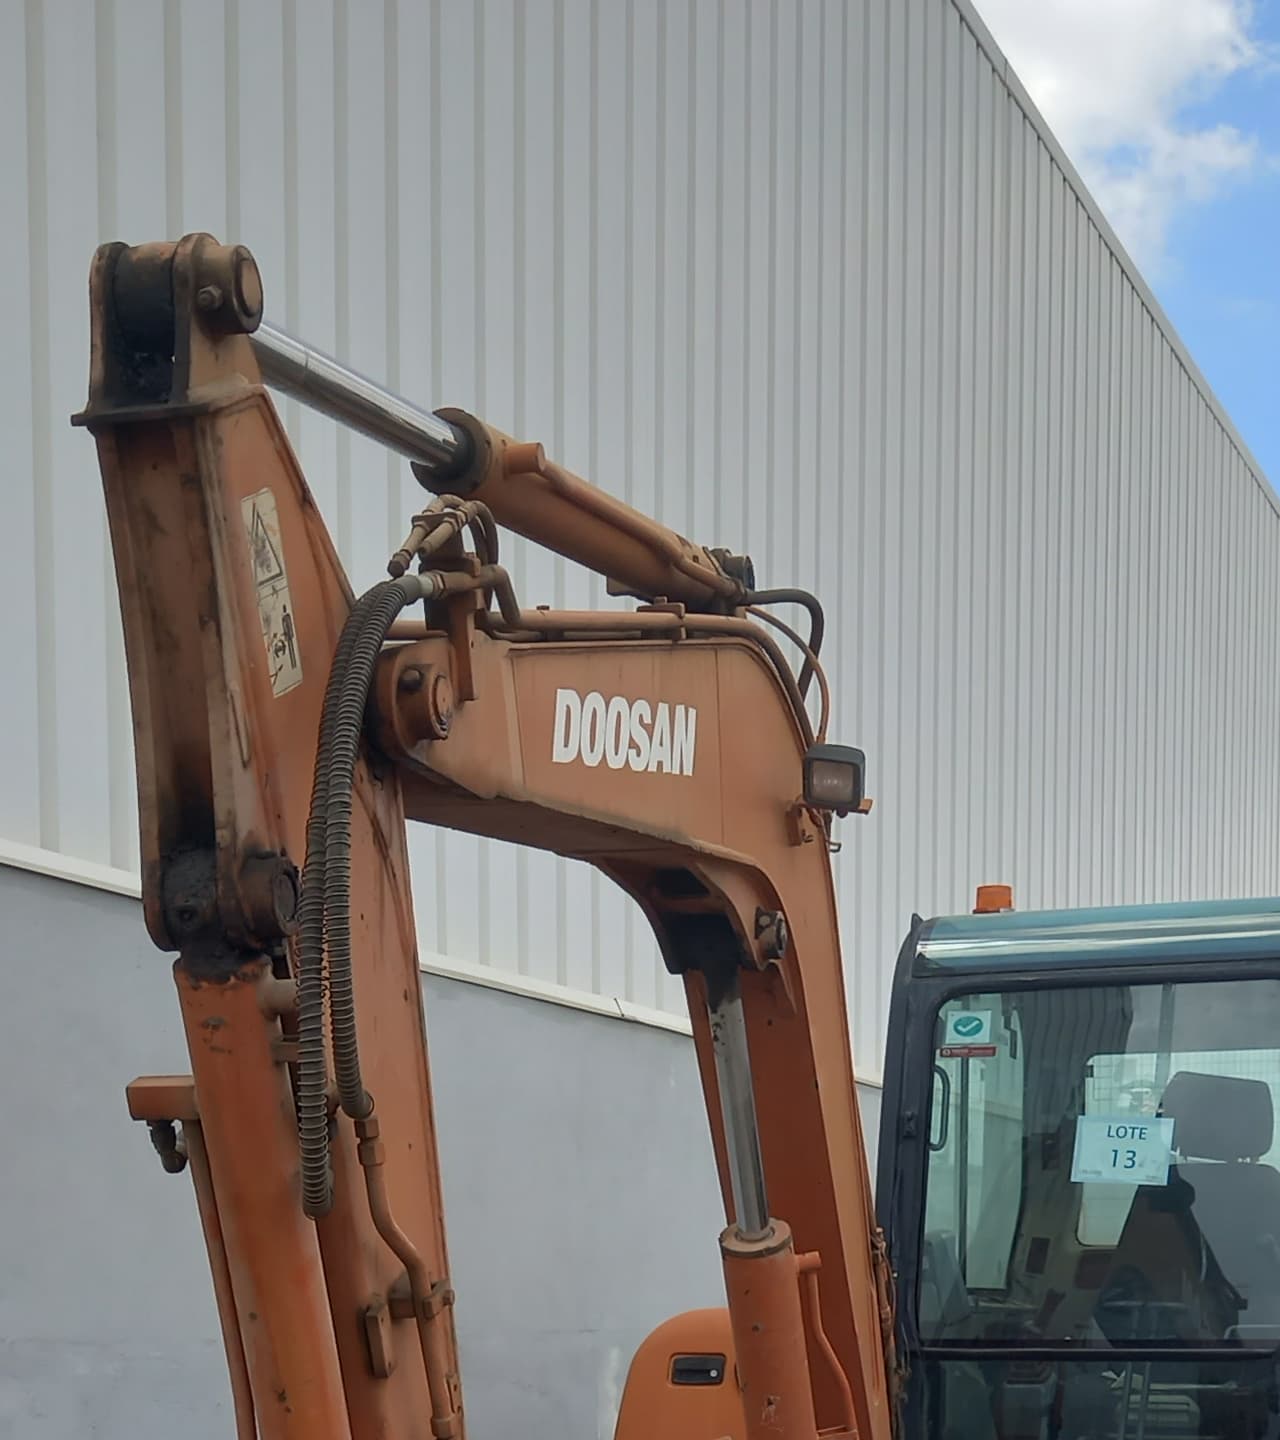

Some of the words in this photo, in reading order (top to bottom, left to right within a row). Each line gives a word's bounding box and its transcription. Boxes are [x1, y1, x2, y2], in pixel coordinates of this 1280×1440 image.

[552, 688, 696, 776] DOOSAN
[1107, 1125, 1148, 1140] LOTE
[1111, 1149, 1137, 1169] 13
